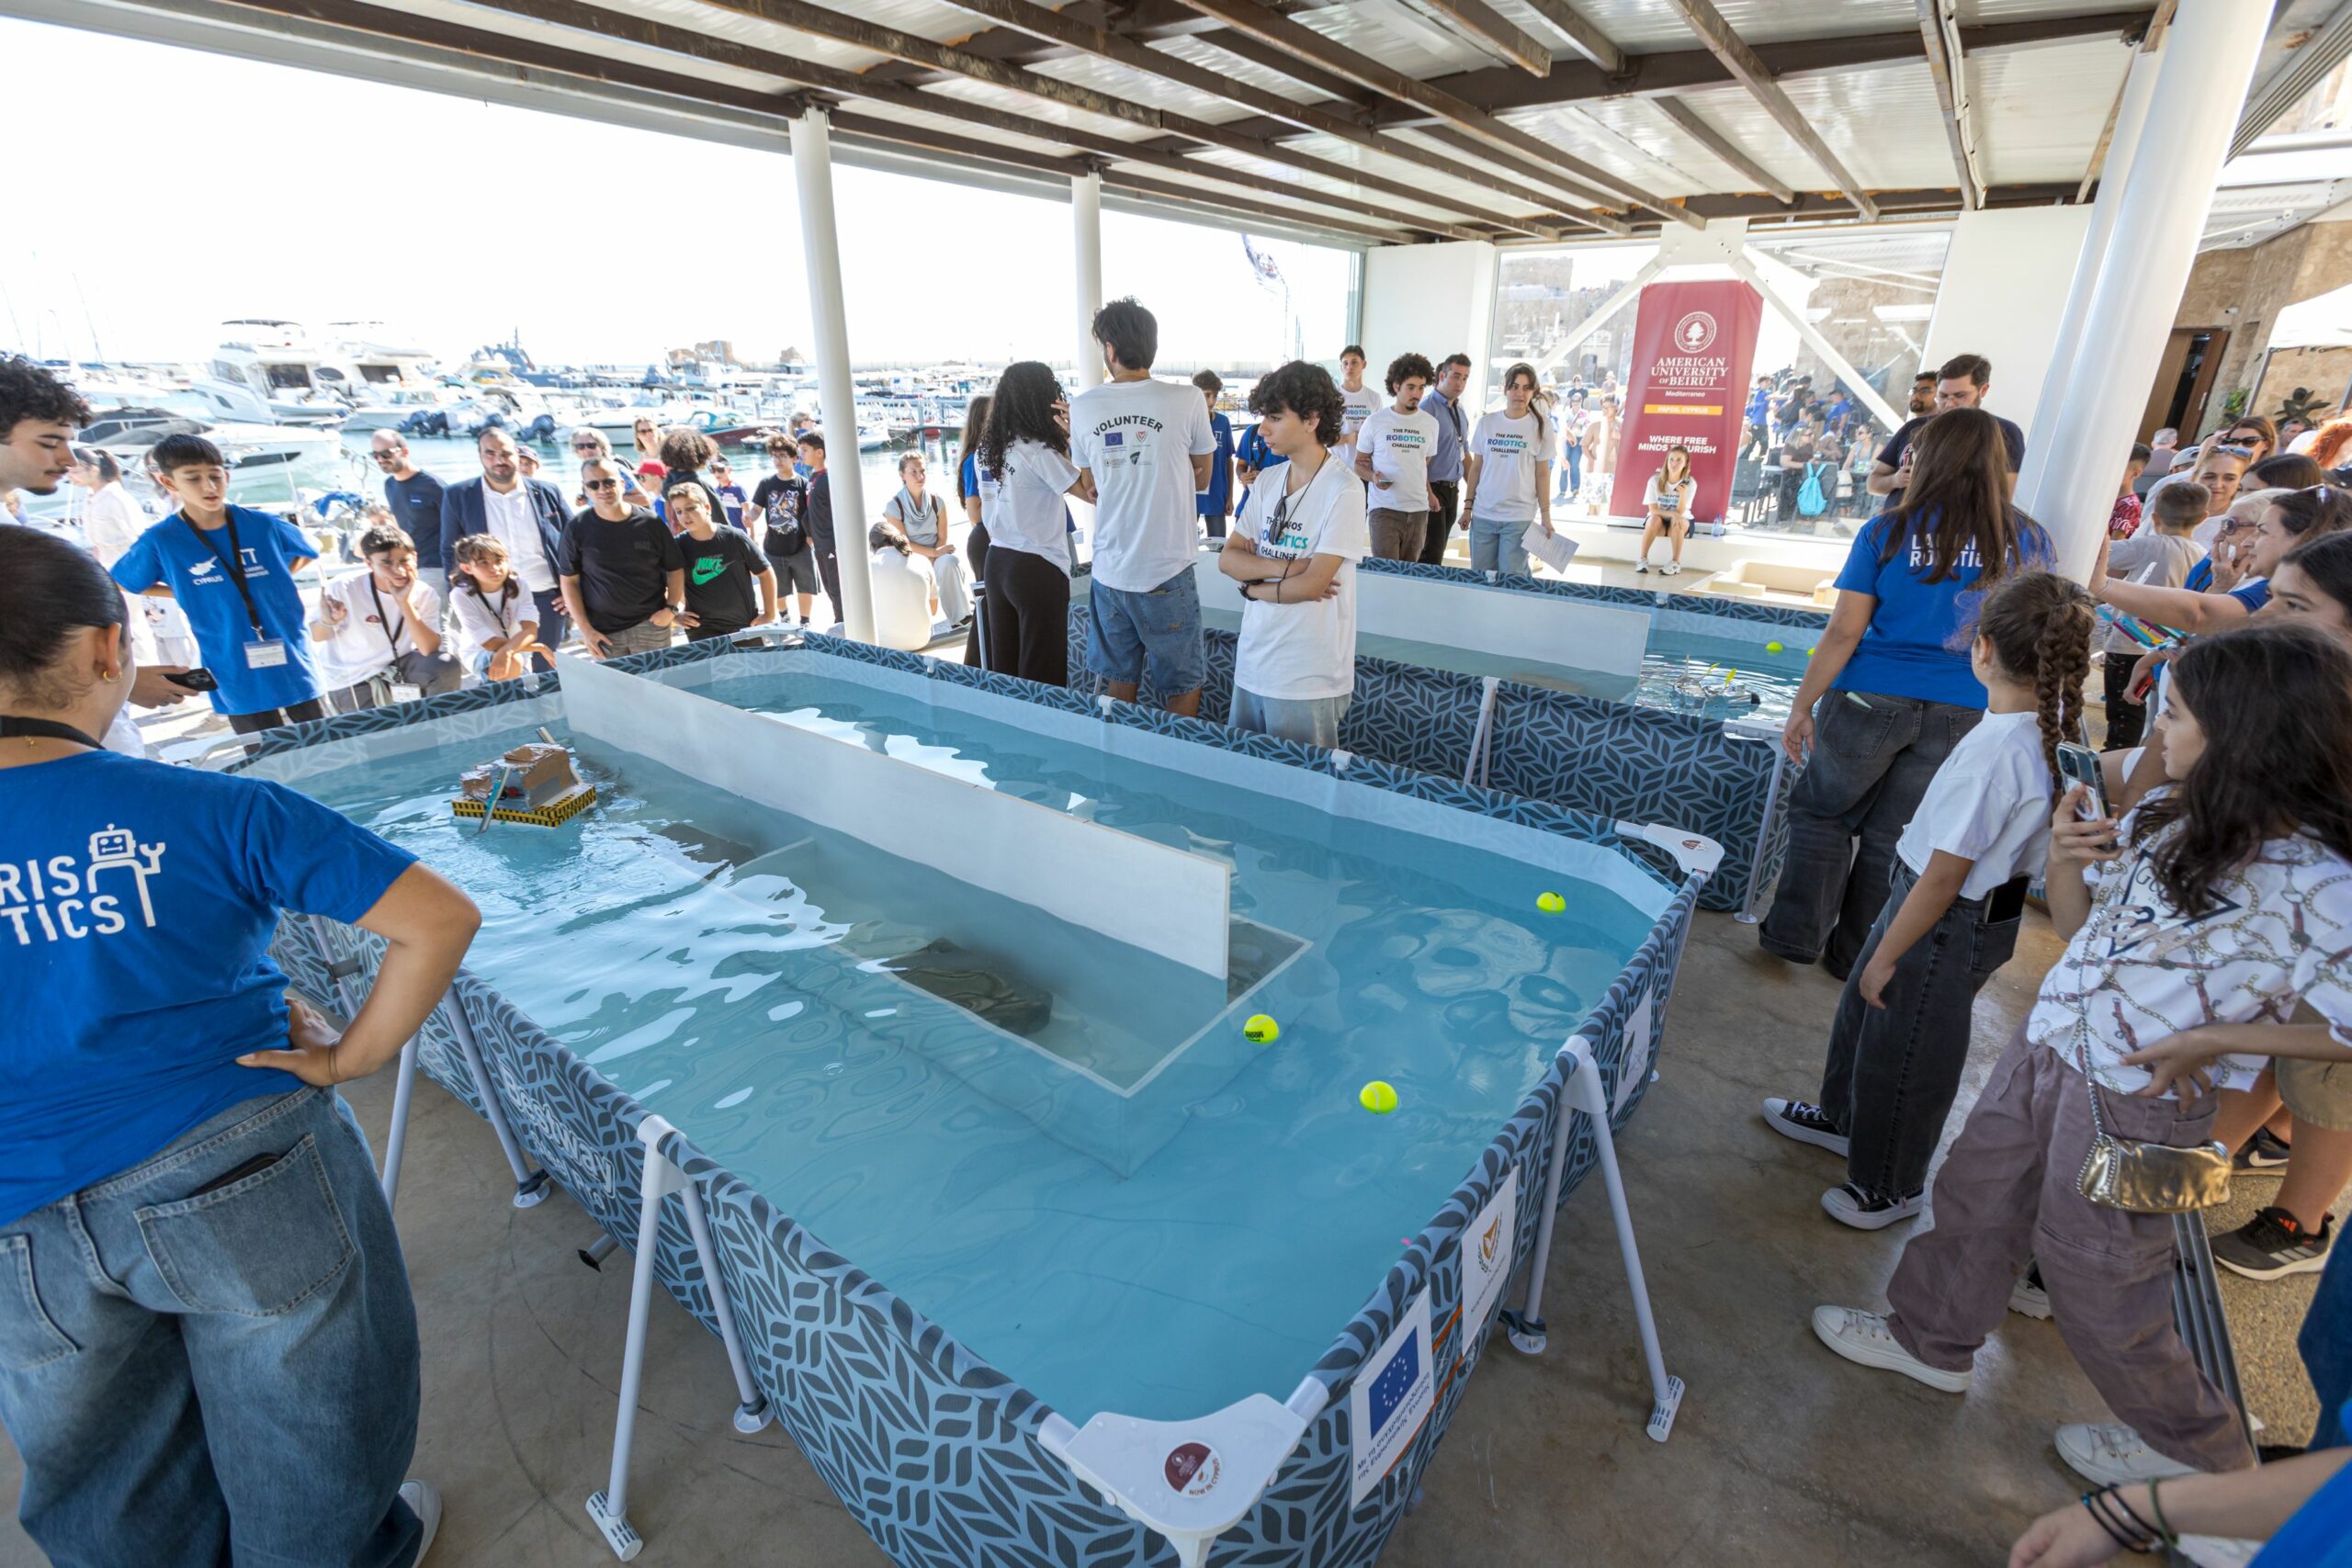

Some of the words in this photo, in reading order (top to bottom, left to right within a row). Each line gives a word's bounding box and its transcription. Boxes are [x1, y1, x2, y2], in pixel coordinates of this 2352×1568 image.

[1657, 357, 1726, 367] AMERICAN
[1651, 367, 1729, 377] UNIVERSITY
[1669, 377, 1717, 386] BEIRUT
[1093, 415, 1163, 436] VOLUNTEER
[1386, 434, 1425, 444] ROBOTICS
[1487, 438, 1528, 448] ROBOTICS
[1649, 435, 1682, 444] WHERE
[1684, 436, 1708, 446] FREE
[1638, 443, 1668, 452] MINDS
[696, 557, 723, 571] NIKE
[0, 895, 126, 945] TICS
[497, 1057, 616, 1199] Bestway
